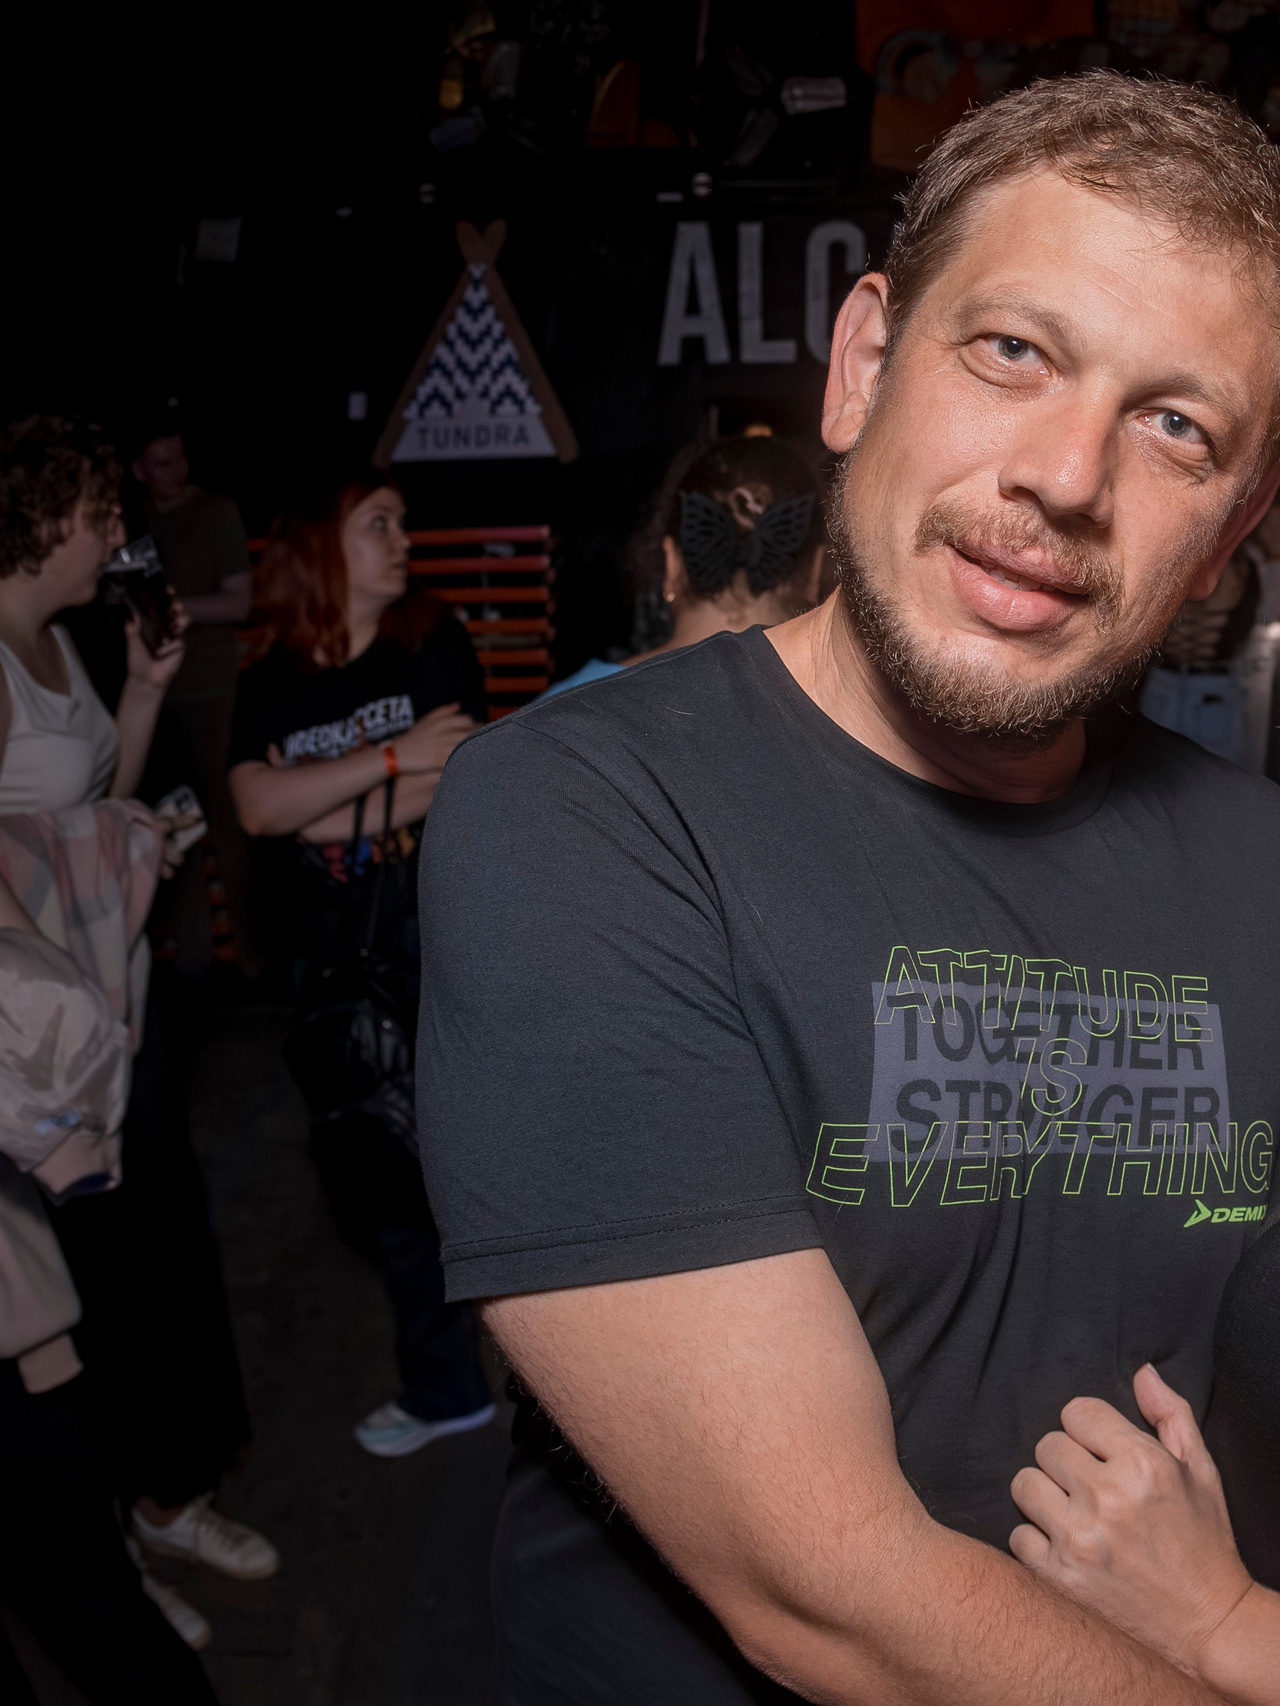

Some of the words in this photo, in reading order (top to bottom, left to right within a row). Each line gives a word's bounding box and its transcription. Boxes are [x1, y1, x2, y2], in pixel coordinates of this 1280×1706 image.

[418, 424, 530, 449] TUNDRA
[873, 945, 1214, 1042] ATTITUDE
[887, 992, 1206, 1072] TOGETHER
[1014, 1036, 1088, 1116] IS
[805, 1119, 1274, 1208] EVERYTHING
